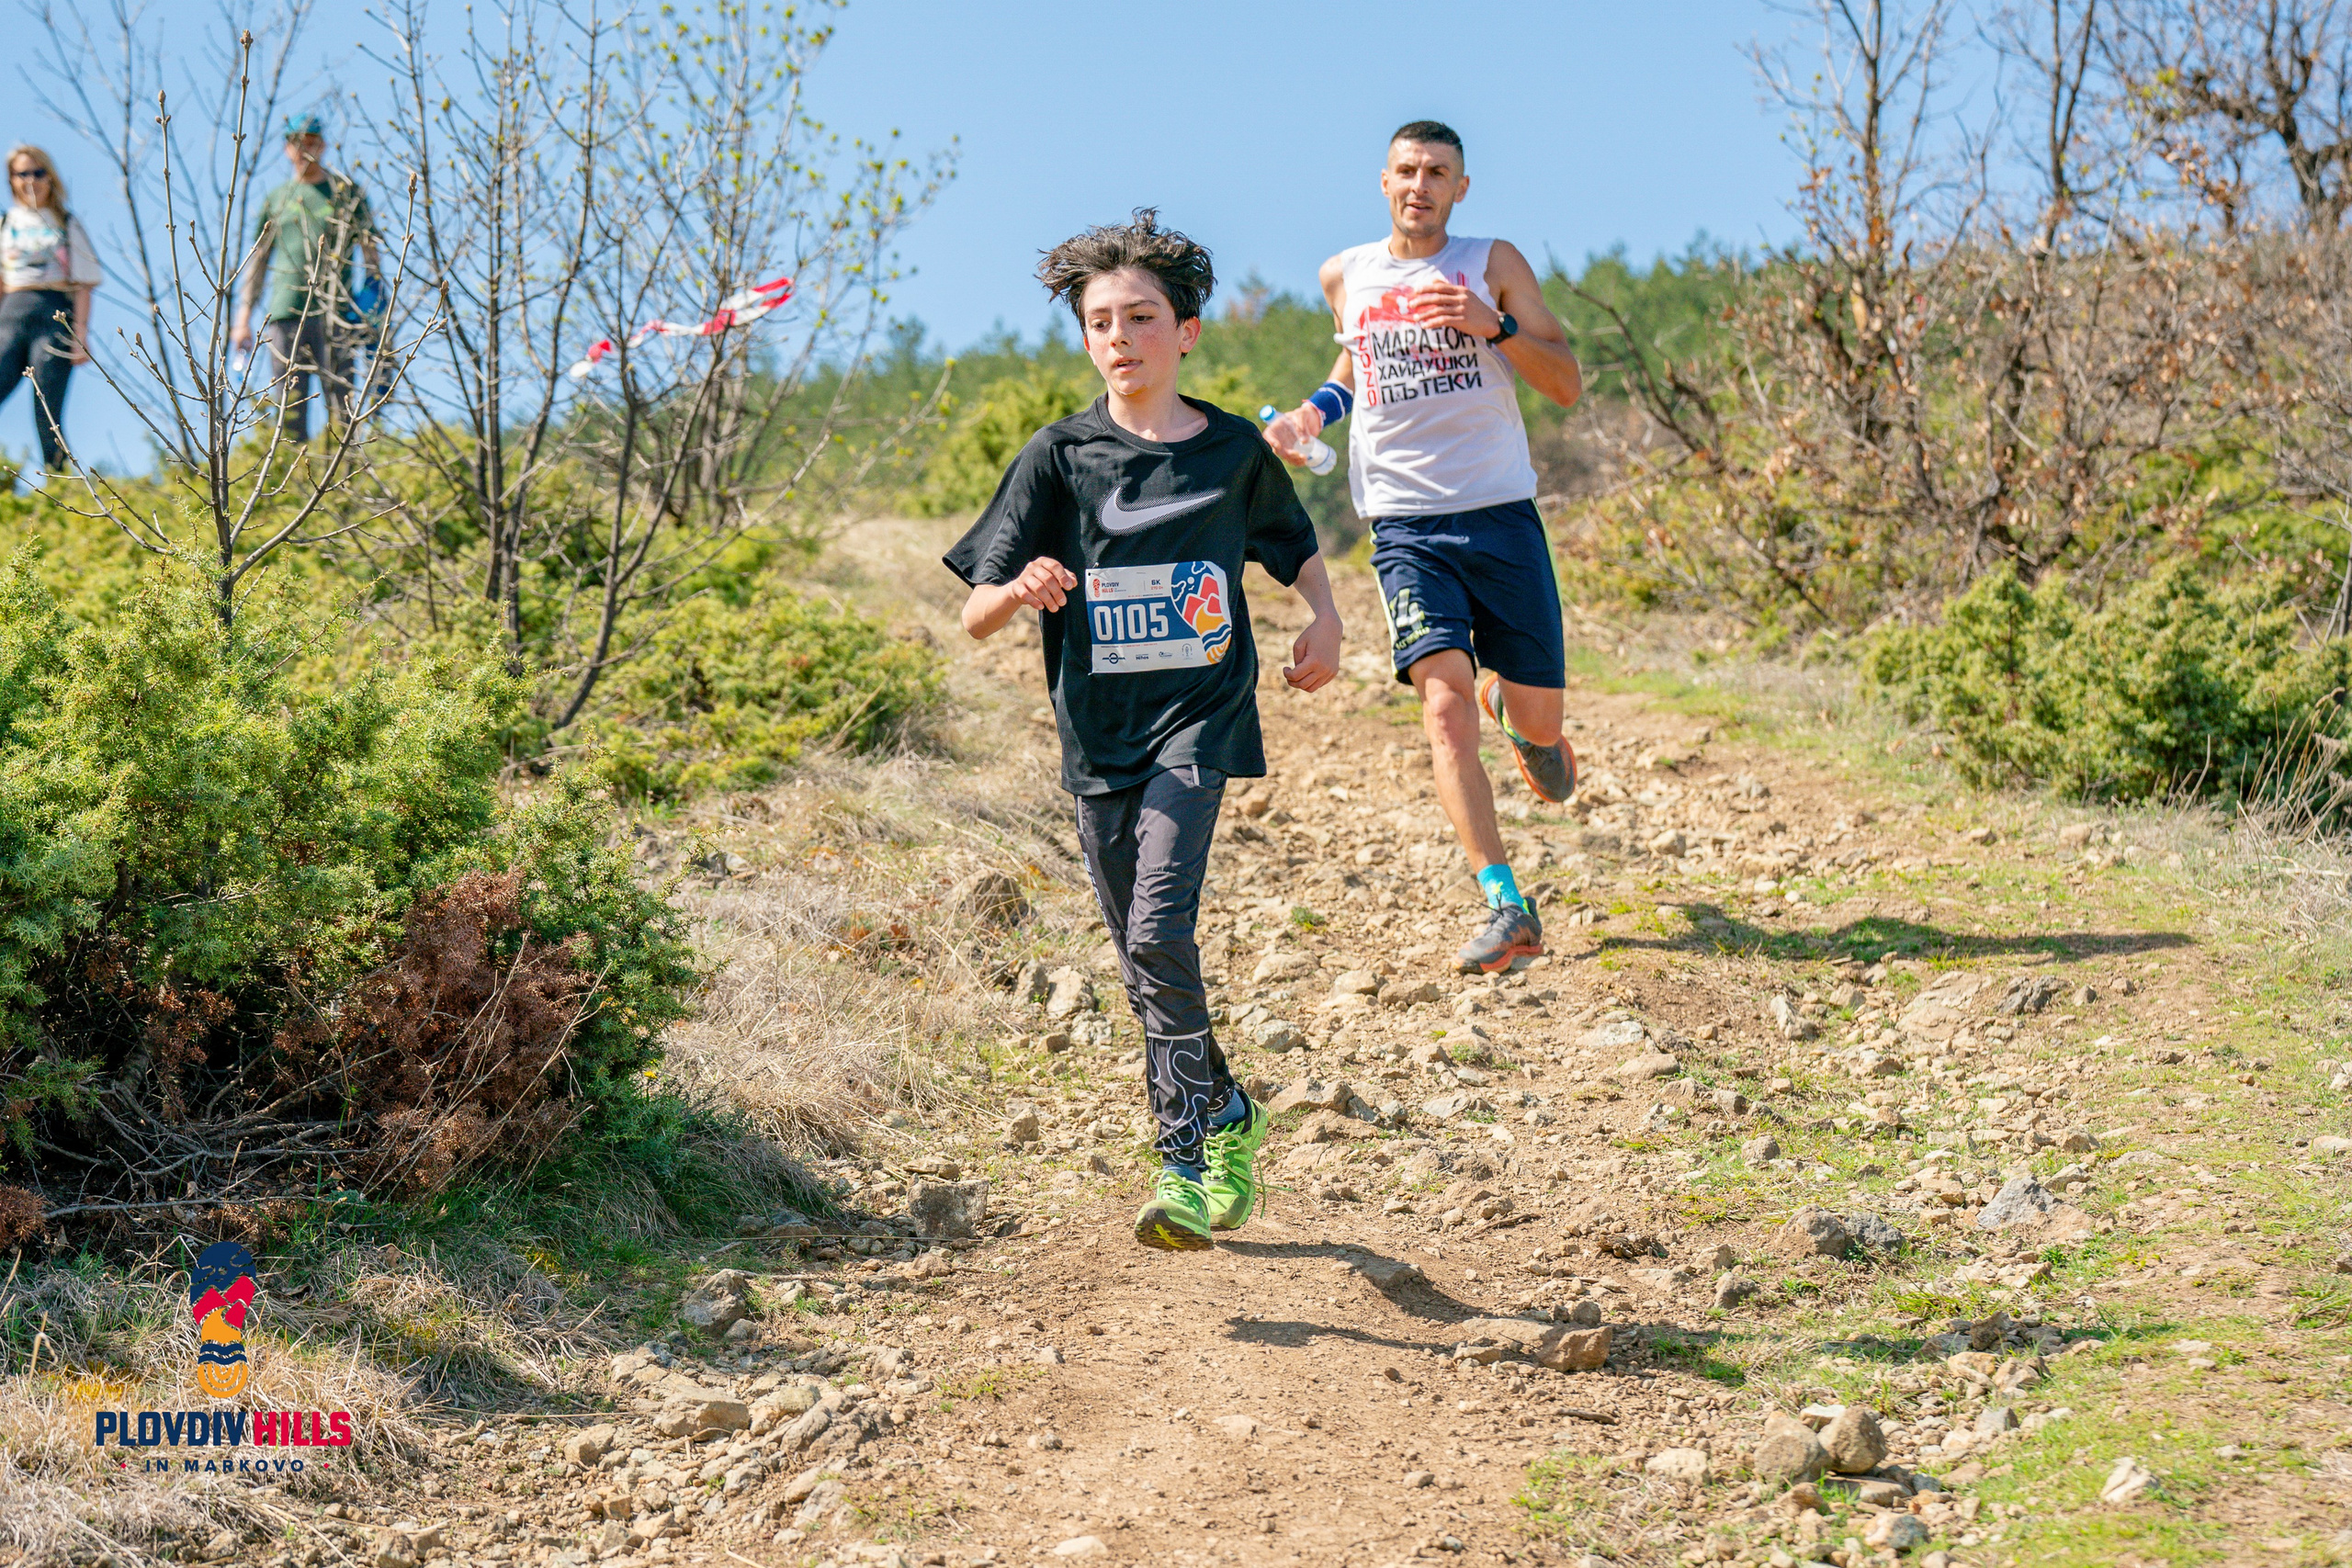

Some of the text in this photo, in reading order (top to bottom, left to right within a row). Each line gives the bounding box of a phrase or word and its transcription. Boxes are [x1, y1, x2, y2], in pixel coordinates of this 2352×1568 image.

[1373, 326, 1476, 360] МАРАТОН
[1378, 353, 1478, 381] ХАЙДУШКИ
[1381, 371, 1482, 404] ПЪТЕКИ
[1093, 602, 1169, 641] 0105
